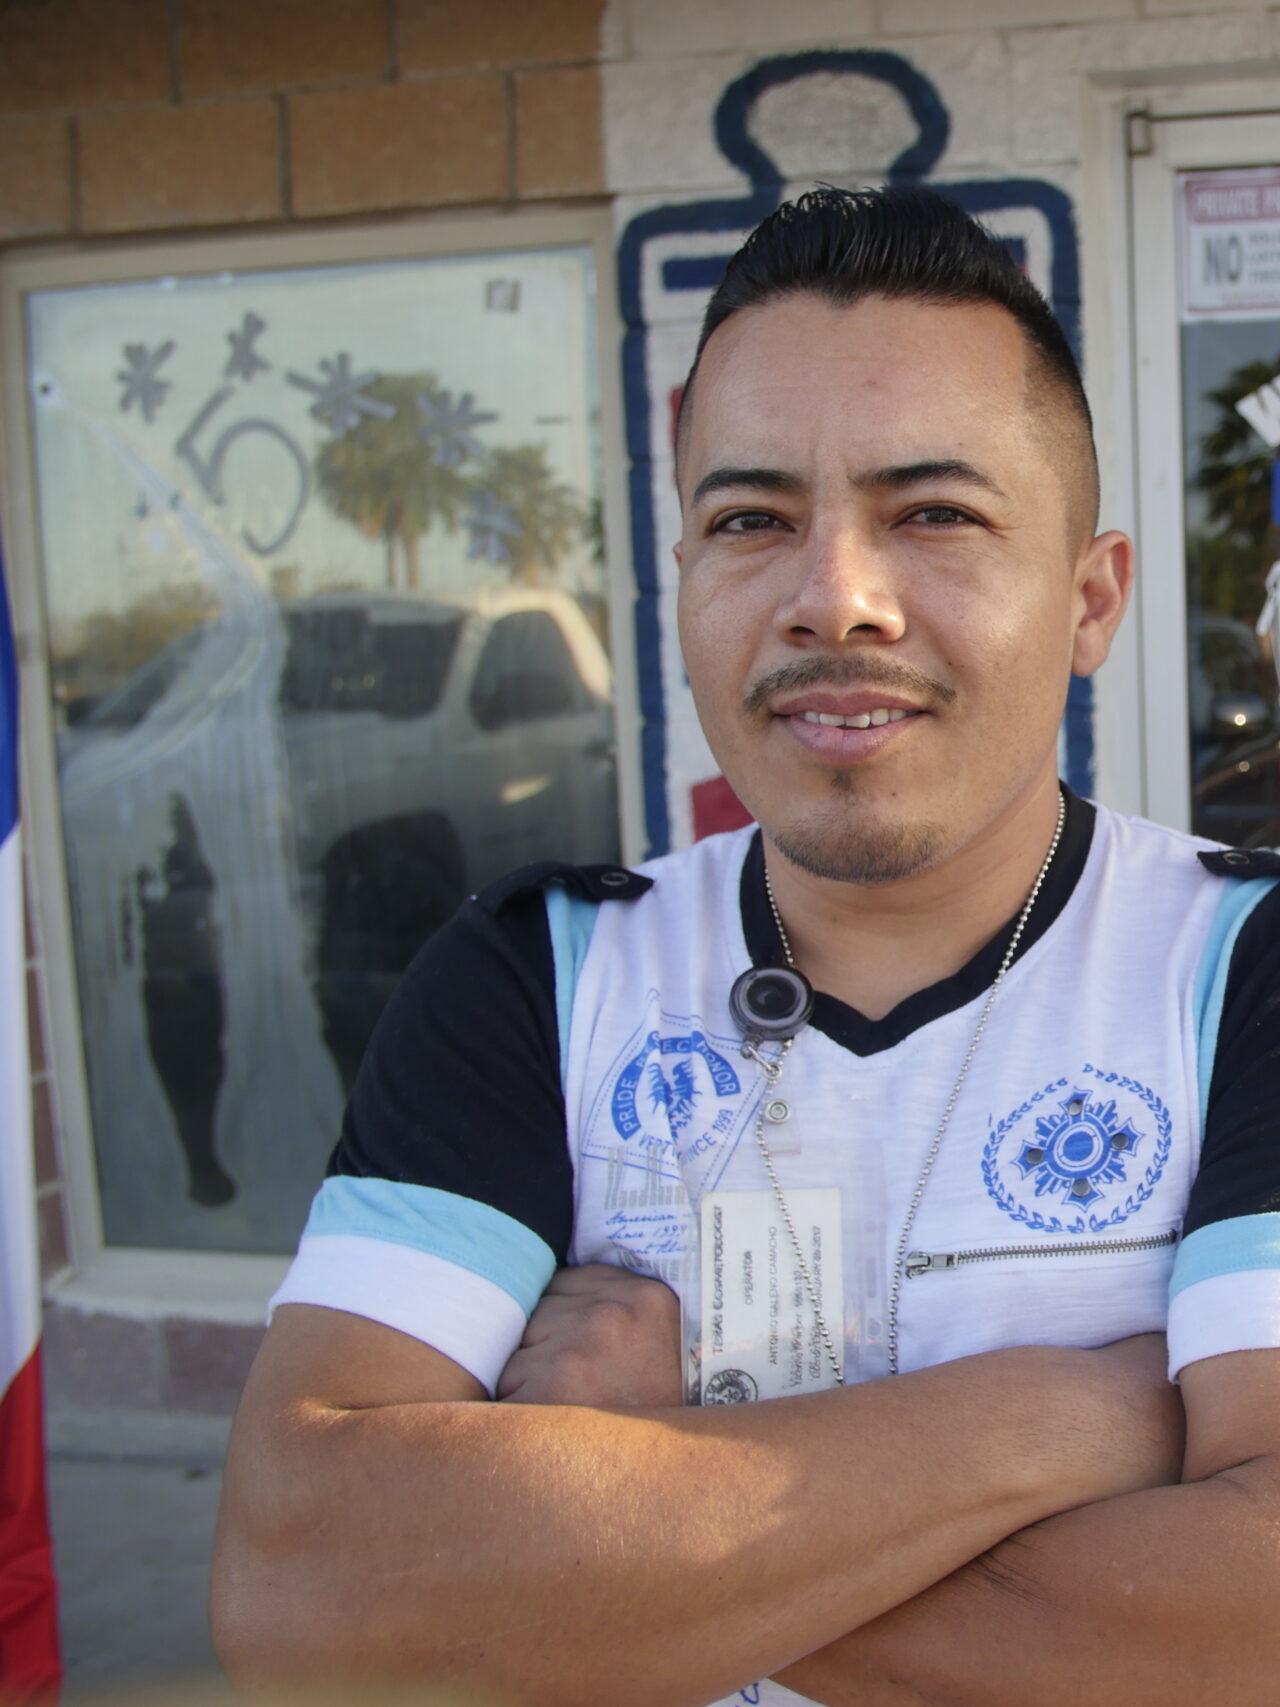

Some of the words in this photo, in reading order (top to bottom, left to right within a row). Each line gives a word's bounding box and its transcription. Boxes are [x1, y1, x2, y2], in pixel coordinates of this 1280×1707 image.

[1203, 233, 1243, 286] NO
[617, 1077, 638, 1132] PRIDE
[696, 1039, 737, 1094] HONOR
[712, 1107, 735, 1134] 1999
[768, 1226, 777, 1276] CAMACHO
[743, 1250, 753, 1305] OPERATOR
[768, 1319, 778, 1366] ANTONIO
